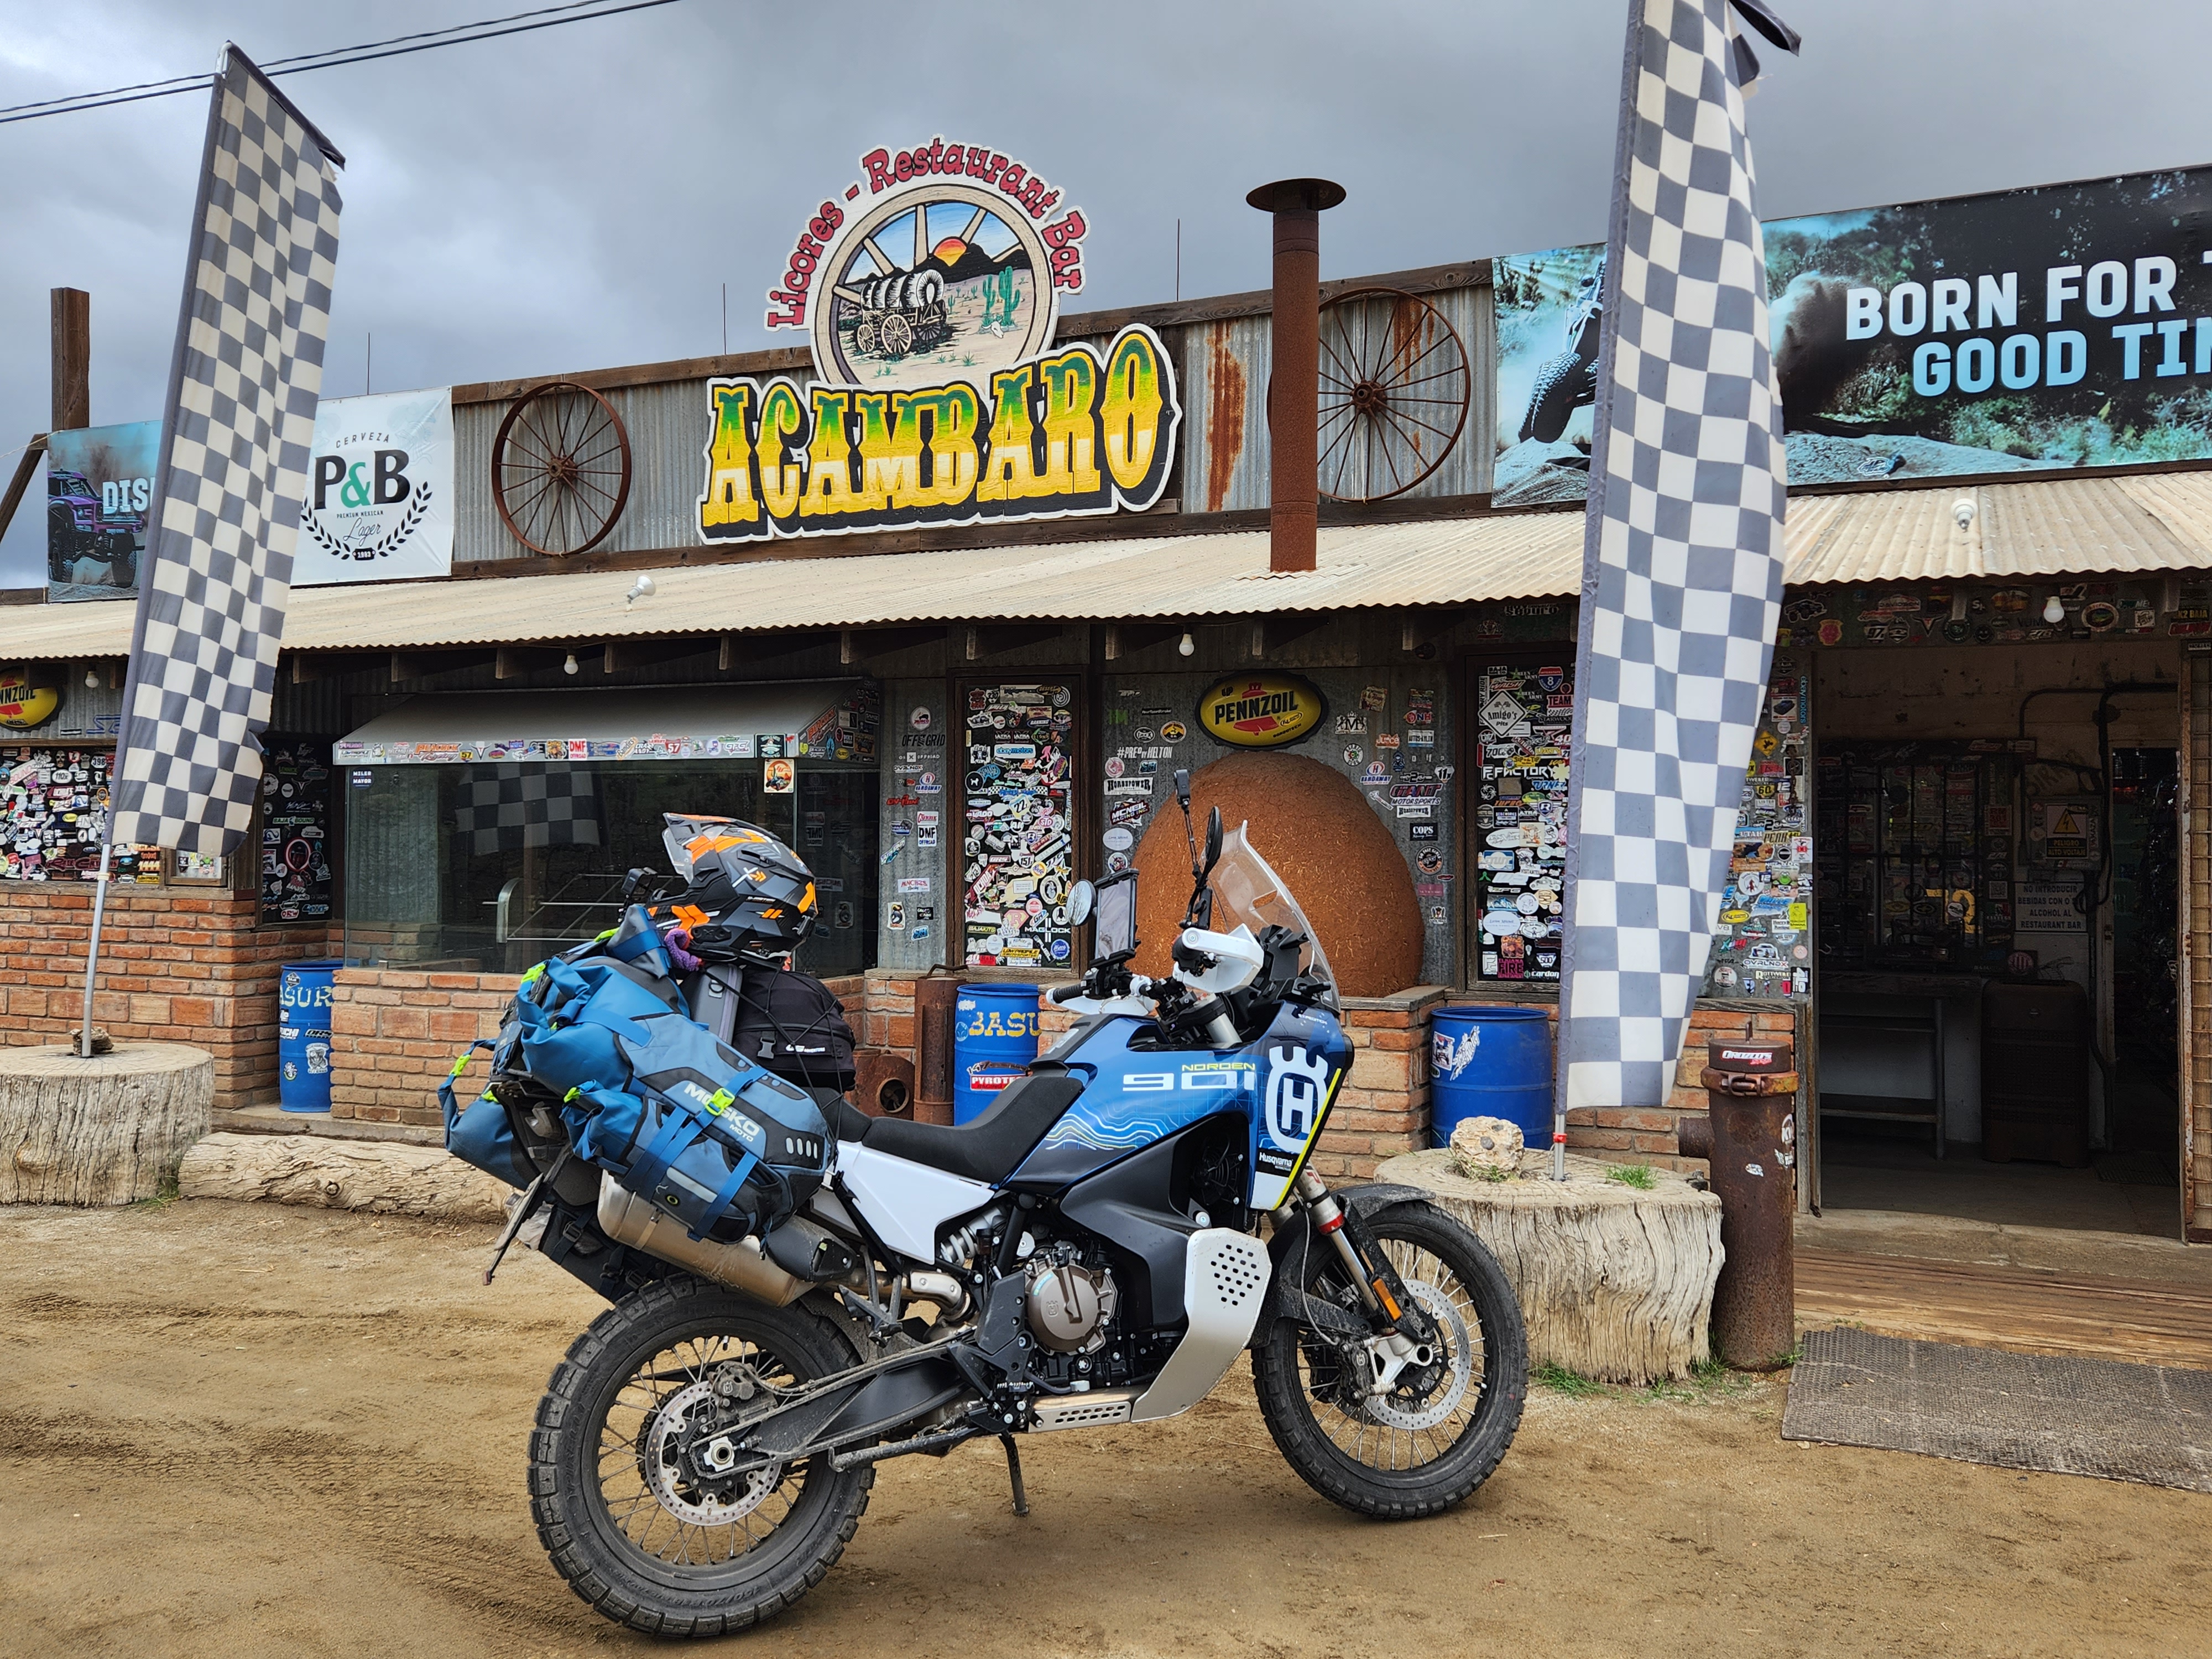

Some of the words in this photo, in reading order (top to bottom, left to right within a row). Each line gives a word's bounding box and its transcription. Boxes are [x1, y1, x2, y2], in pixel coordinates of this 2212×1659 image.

[768, 201, 845, 327] Licores
[862, 138, 1060, 218] Restaurant
[1042, 210, 1087, 289] Bar
[1846, 271, 2017, 340] BORN
[2047, 256, 2177, 322] FOR
[1913, 330, 2088, 397] GOOD
[702, 333, 1164, 527] ACAMBARO
[336, 432, 389, 448] CERVEZA
[314, 449, 410, 510] P&B
[343, 518, 382, 546] Lager
[1547, 676, 1554, 686] 8
[1548, 695, 1571, 706] TEAM
[1214, 691, 1298, 726] PENNZOIL
[1488, 711, 1517, 721] Amigo's
[570, 740, 586, 752] DMF
[901, 734, 919, 747] OFF
[926, 734, 946, 747] GRID
[667, 743, 680, 754] 57
[1147, 747, 1173, 759] HELTON
[92, 757, 106, 766] 398
[1107, 779, 1151, 792] HORSEPOWER
[1390, 785, 1442, 797] GIANT
[1777, 782, 1791, 791] 12
[1112, 802, 1147, 820] MCNEIL
[1113, 809, 1135, 823] RACING
[919, 827, 936, 839] DMF
[1412, 826, 1434, 834] COPS
[138, 860, 160, 872] 1444
[1024, 926, 1071, 934] MAGLOCK
[2021, 921, 2065, 929] RESTAURANT
[1499, 963, 1524, 974] FIRE
[1182, 1063, 1255, 1071] NORDEN
[1123, 1071, 1255, 1092] 901
[729, 1123, 754, 1142] MOTO
[1259, 1152, 1293, 1167] Husqvarna
